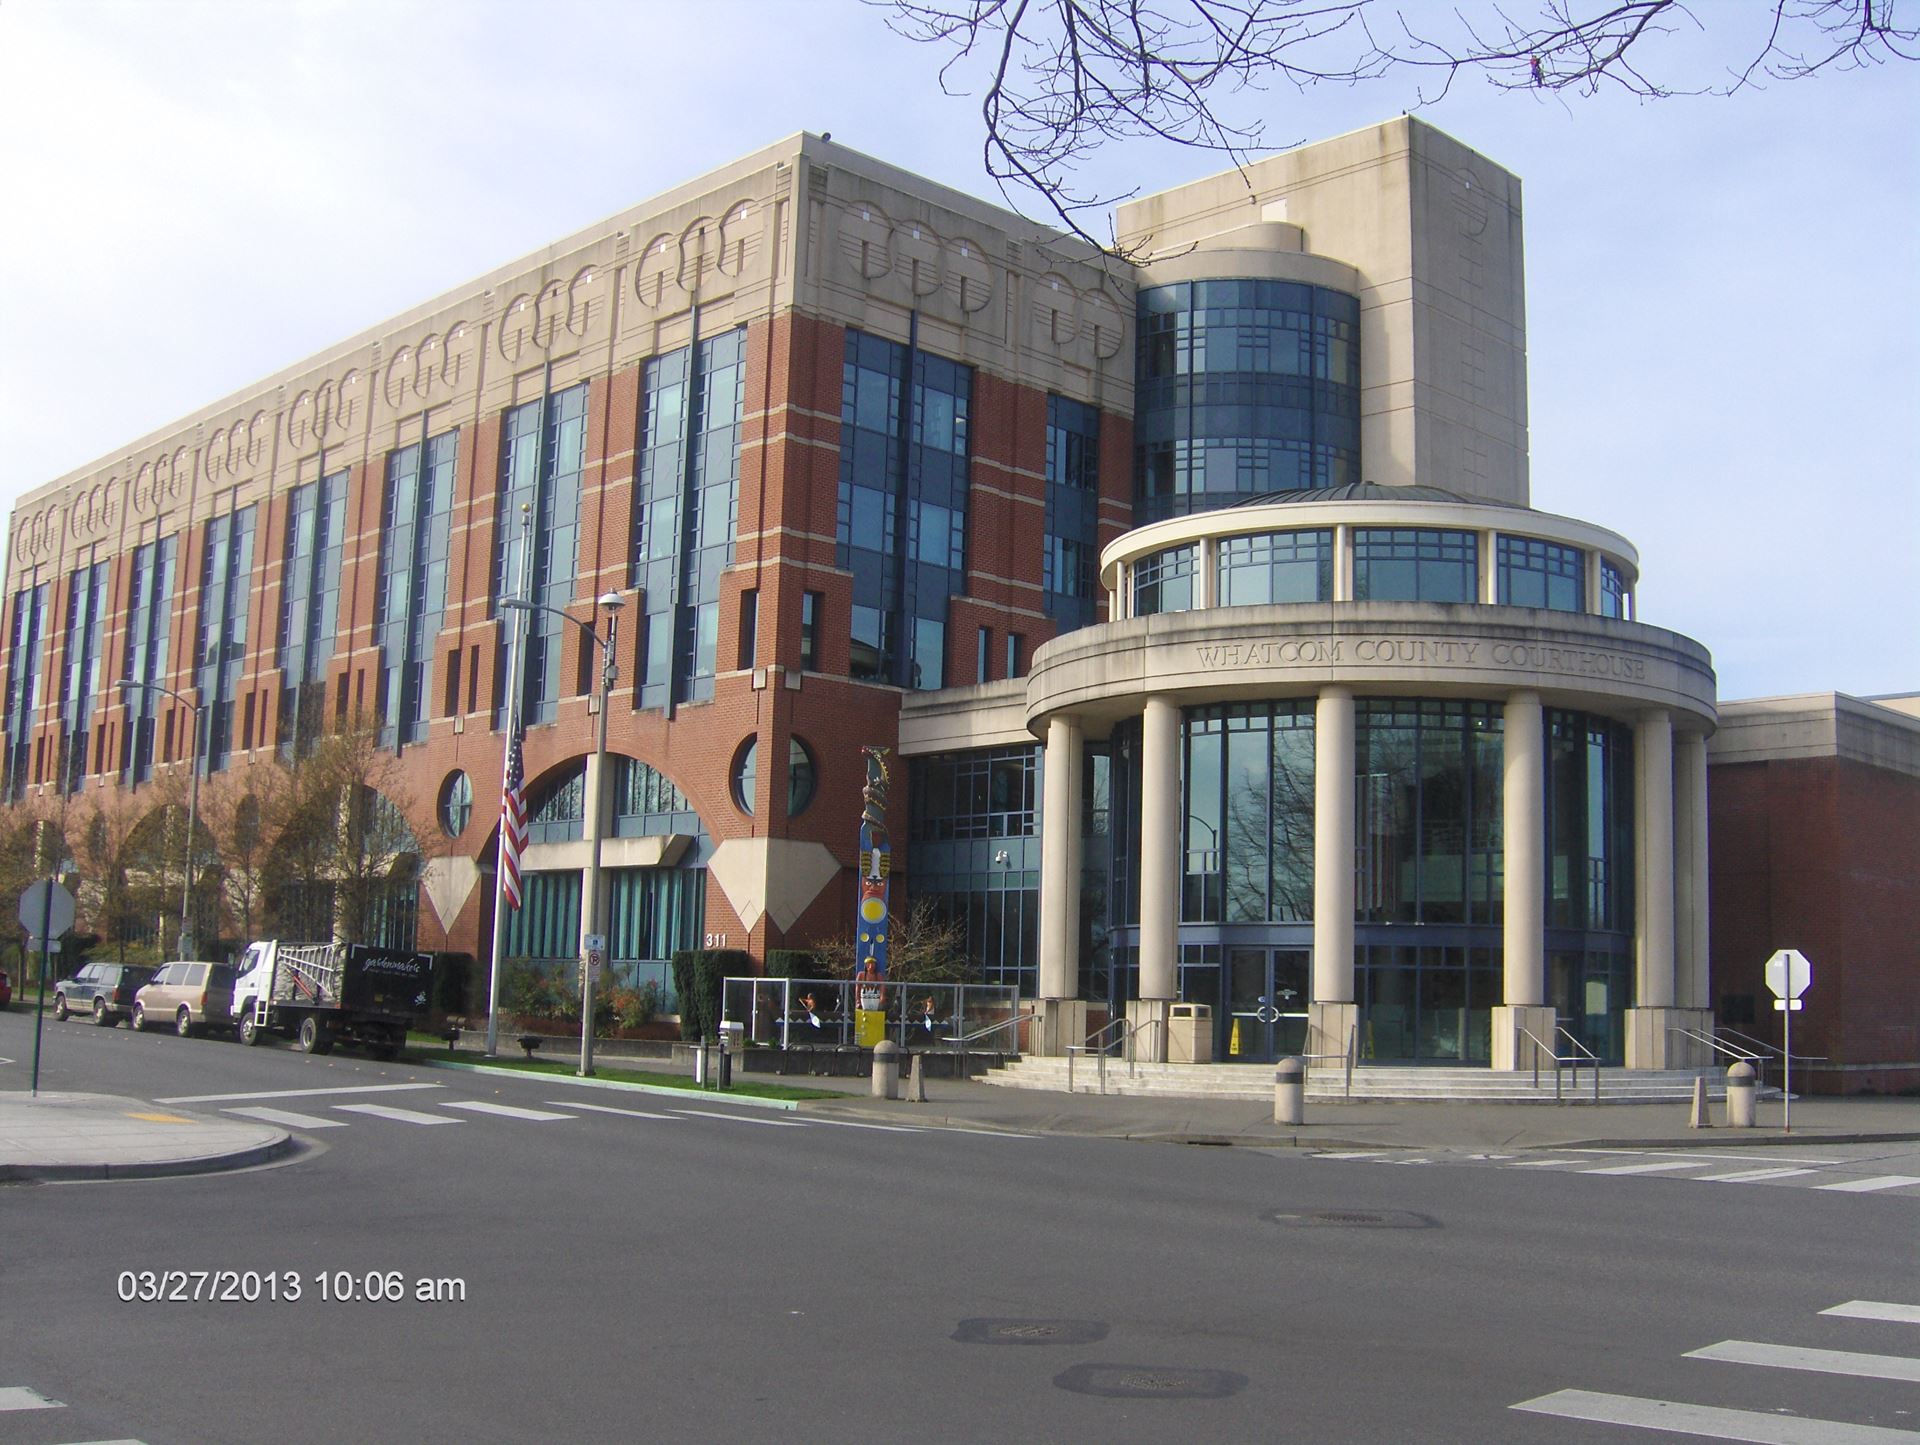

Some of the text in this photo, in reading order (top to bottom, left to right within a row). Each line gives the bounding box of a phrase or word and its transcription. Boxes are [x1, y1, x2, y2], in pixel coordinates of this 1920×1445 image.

[1197, 639, 1645, 680] WHATCOM COUNTY COURTHOUSE
[706, 933, 726, 947] 311
